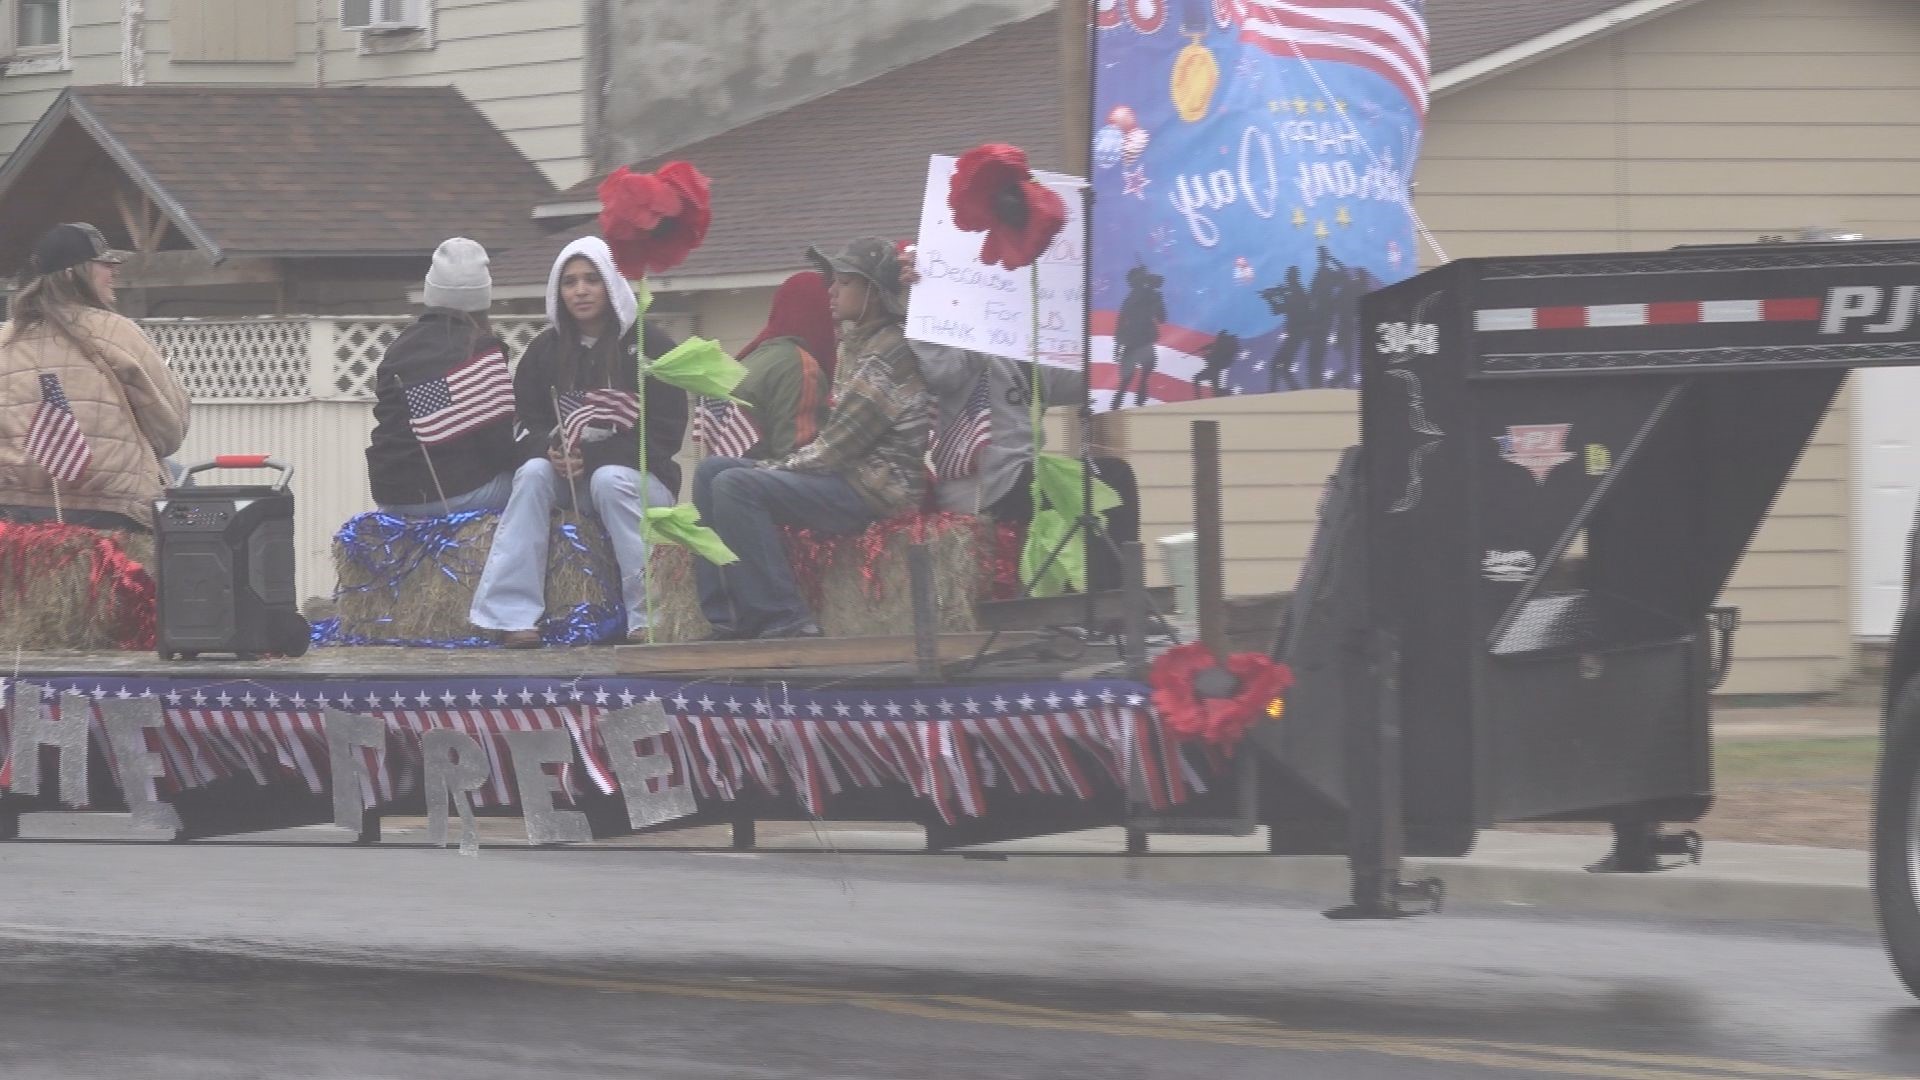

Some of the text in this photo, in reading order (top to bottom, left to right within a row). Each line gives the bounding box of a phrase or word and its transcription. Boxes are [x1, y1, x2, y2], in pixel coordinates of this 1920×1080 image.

[922, 249, 1018, 293] Because
[983, 299, 1023, 323] For
[1820, 284, 1920, 335] PJ
[913, 314, 977, 344] THANK
[985, 328, 1018, 347] YOU
[1375, 320, 1441, 356] 3048
[322, 700, 699, 858] FREE
